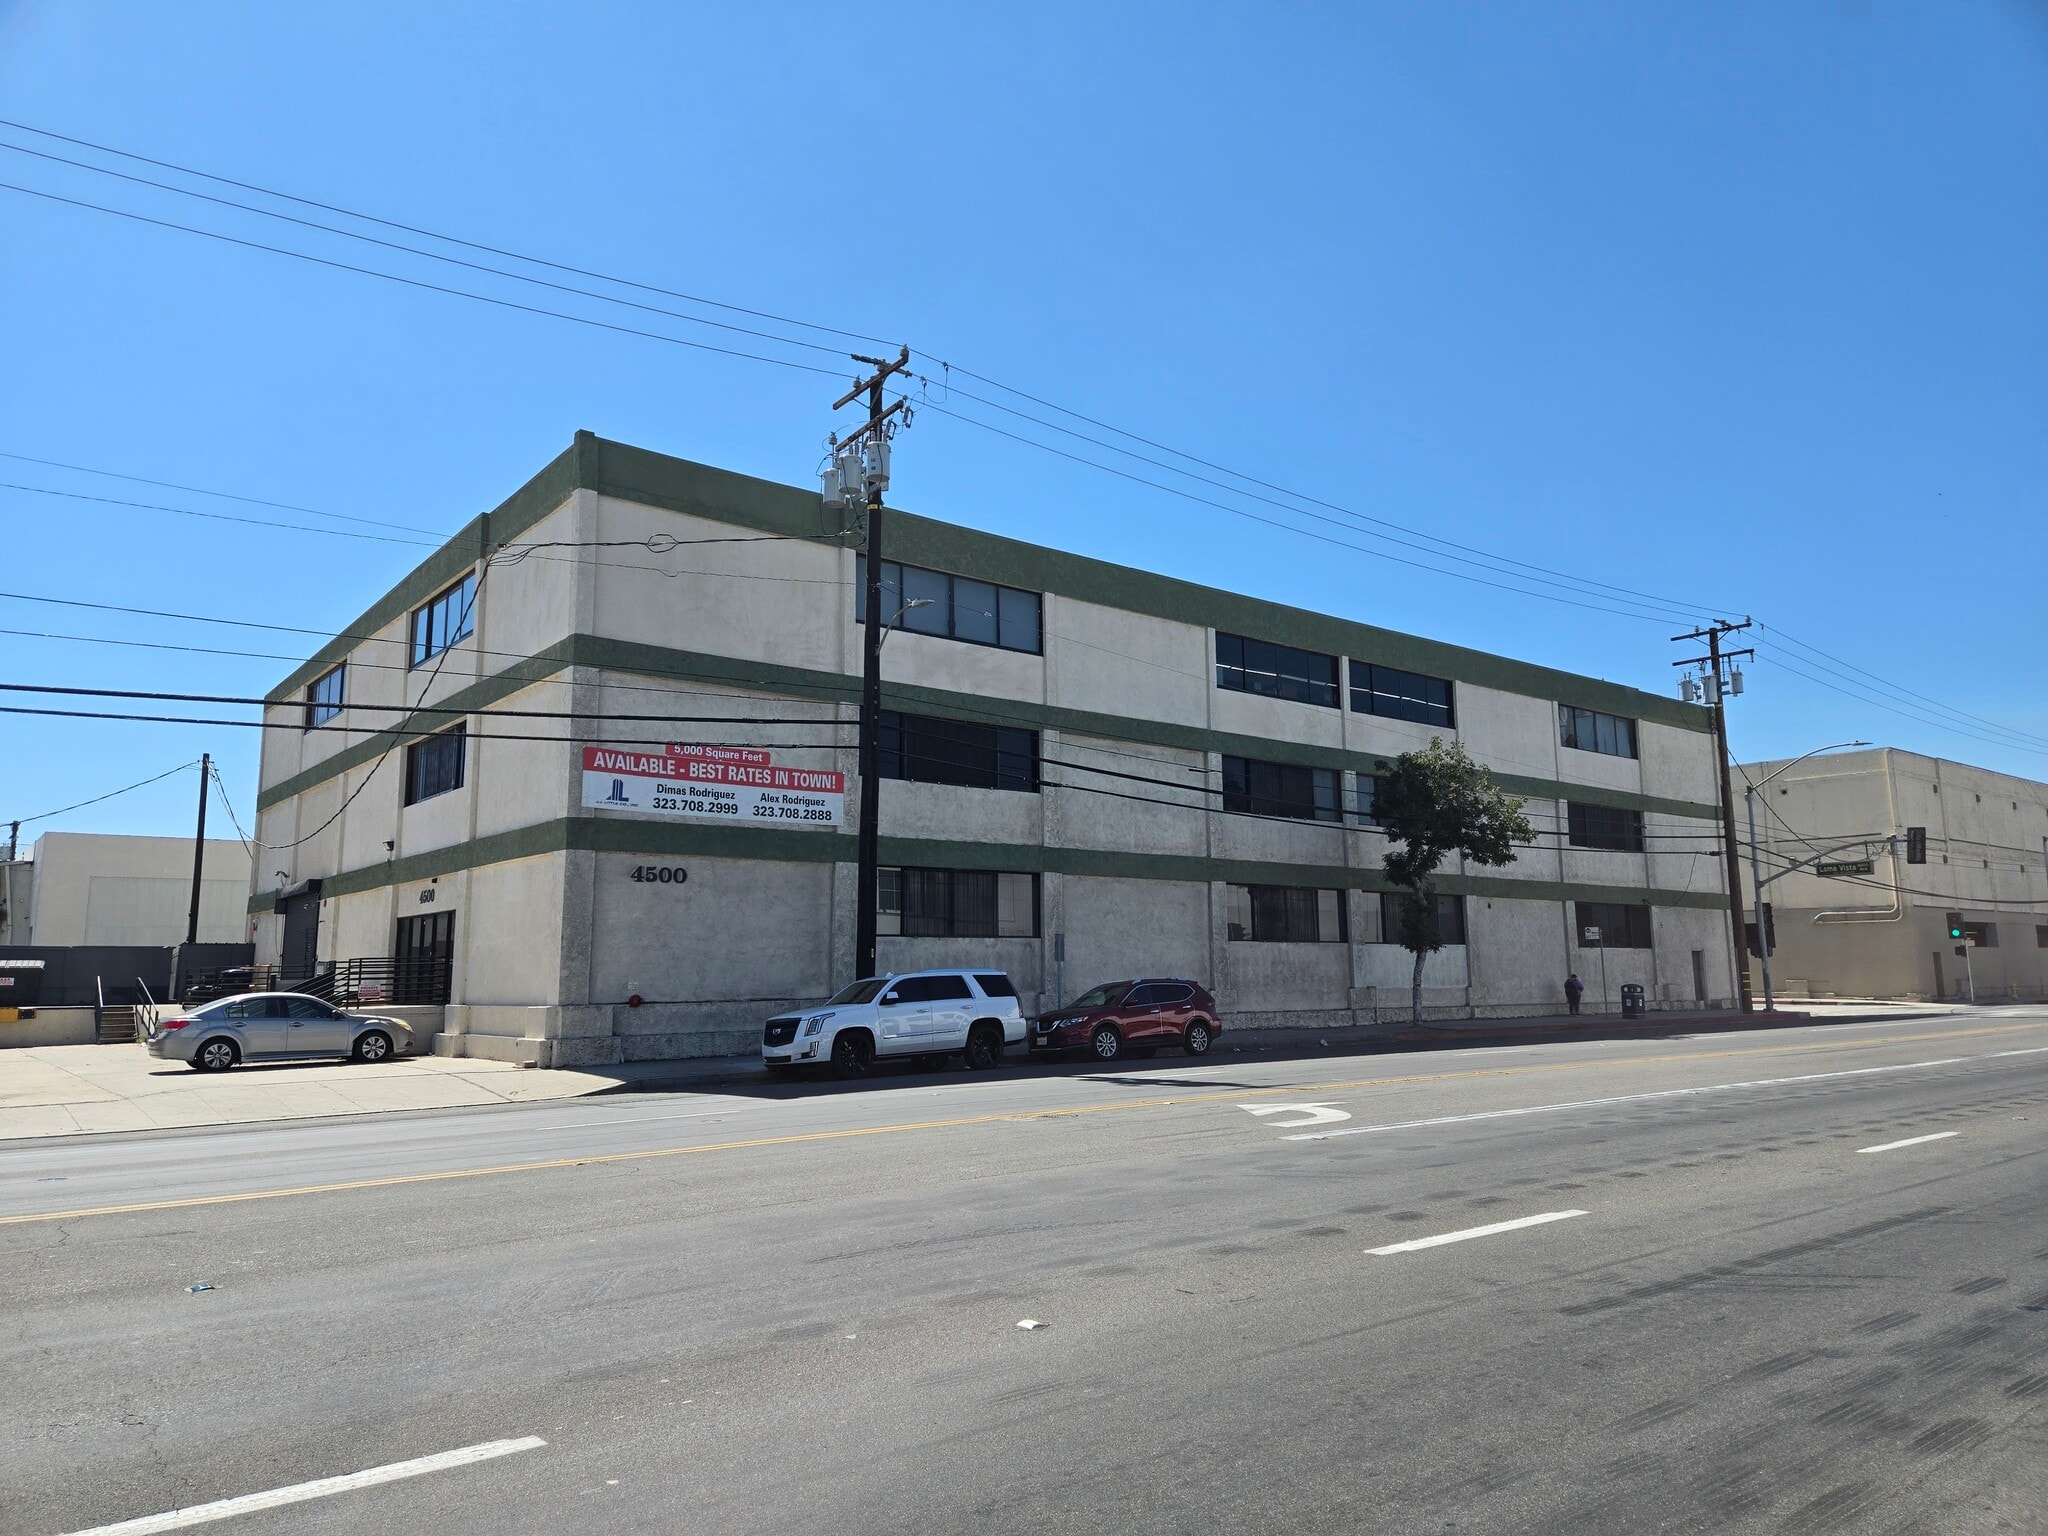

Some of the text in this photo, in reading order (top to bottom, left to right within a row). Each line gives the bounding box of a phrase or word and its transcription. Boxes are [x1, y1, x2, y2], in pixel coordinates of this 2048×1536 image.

[705, 747, 740, 759] Square
[742, 751, 763, 762] Feet
[593, 751, 675, 775] AVAILABLE
[689, 762, 725, 780] BEST
[728, 765, 771, 784] RATES
[775, 770, 789, 786] IN
[792, 772, 836, 789] TOWN!
[656, 783, 736, 801] Dimas Rodriguez
[760, 792, 826, 808] Alex Rodriguez
[652, 797, 739, 815] 323.708.2999
[752, 805, 832, 821] 323.708.2888
[630, 865, 688, 884] 4500
[419, 888, 435, 905] 4500
